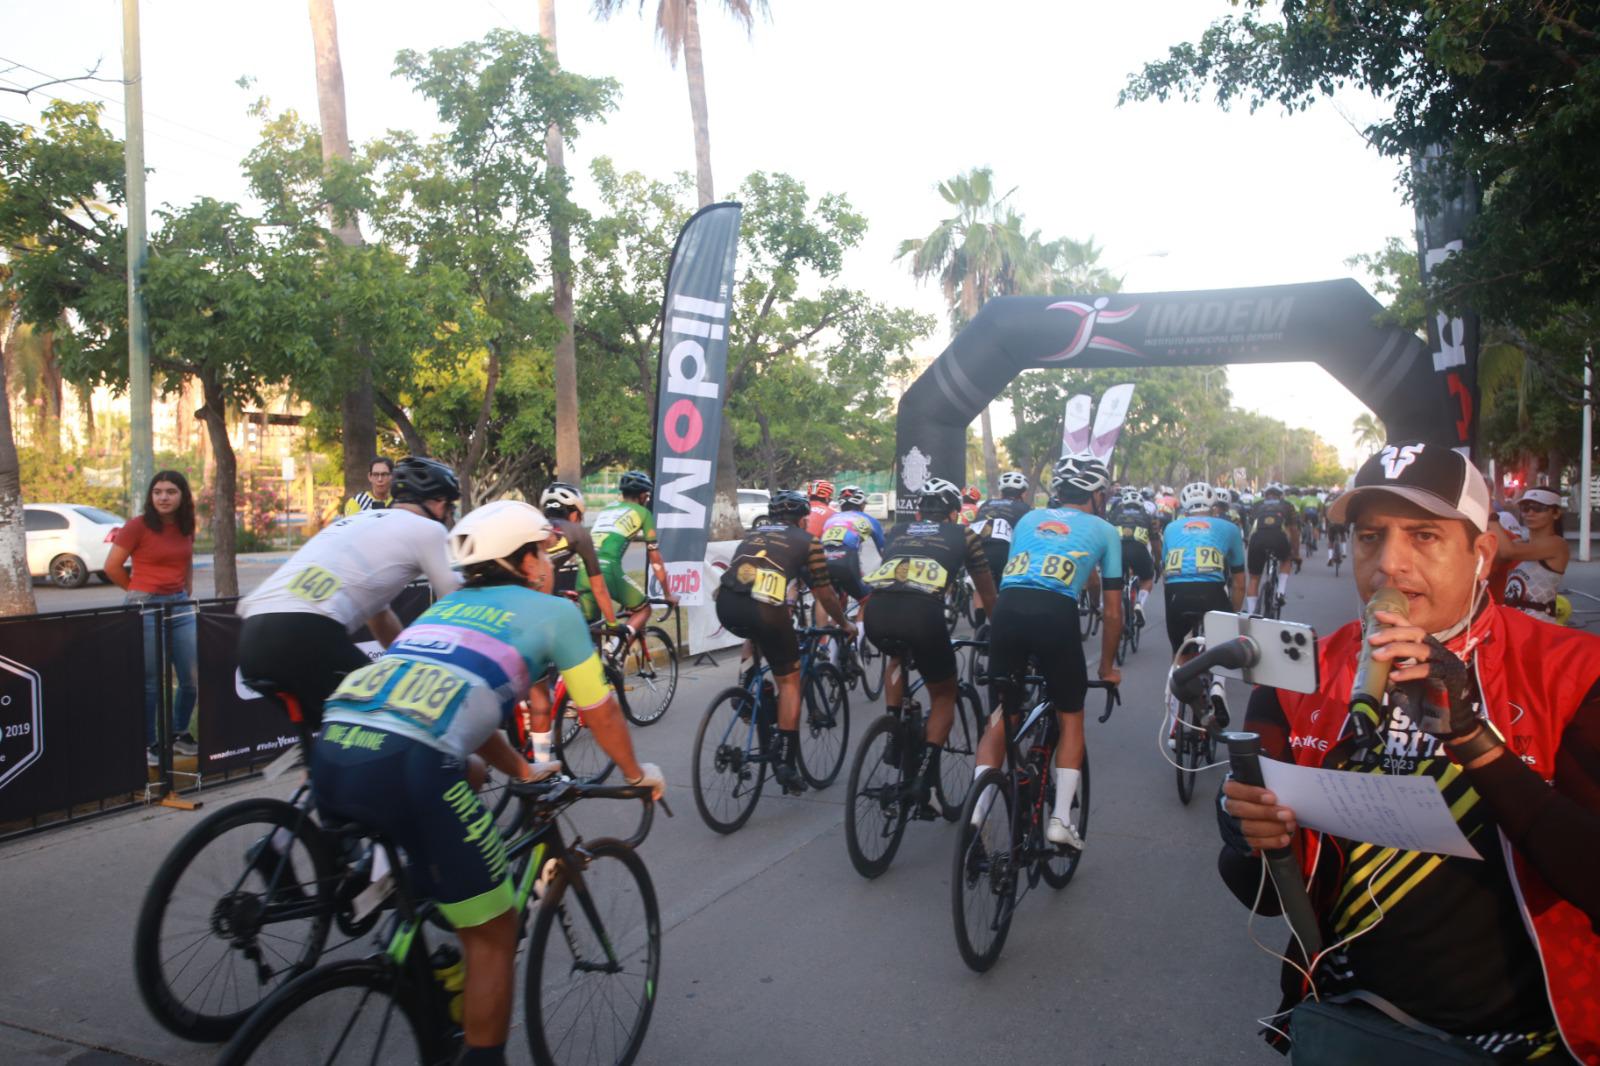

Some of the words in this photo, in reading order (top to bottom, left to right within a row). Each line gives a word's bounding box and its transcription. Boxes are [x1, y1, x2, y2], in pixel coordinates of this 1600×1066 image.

[1146, 296, 1295, 336] IMDEM
[1200, 548, 1220, 565] 90
[913, 560, 939, 581] 98
[1043, 555, 1075, 581] 89
[291, 566, 336, 599] 140
[760, 572, 779, 595] 101
[400, 667, 457, 709] 108
[5, 722, 31, 738] 2019
[208, 746, 251, 761] venados.com
[1383, 757, 1415, 771] 2023
